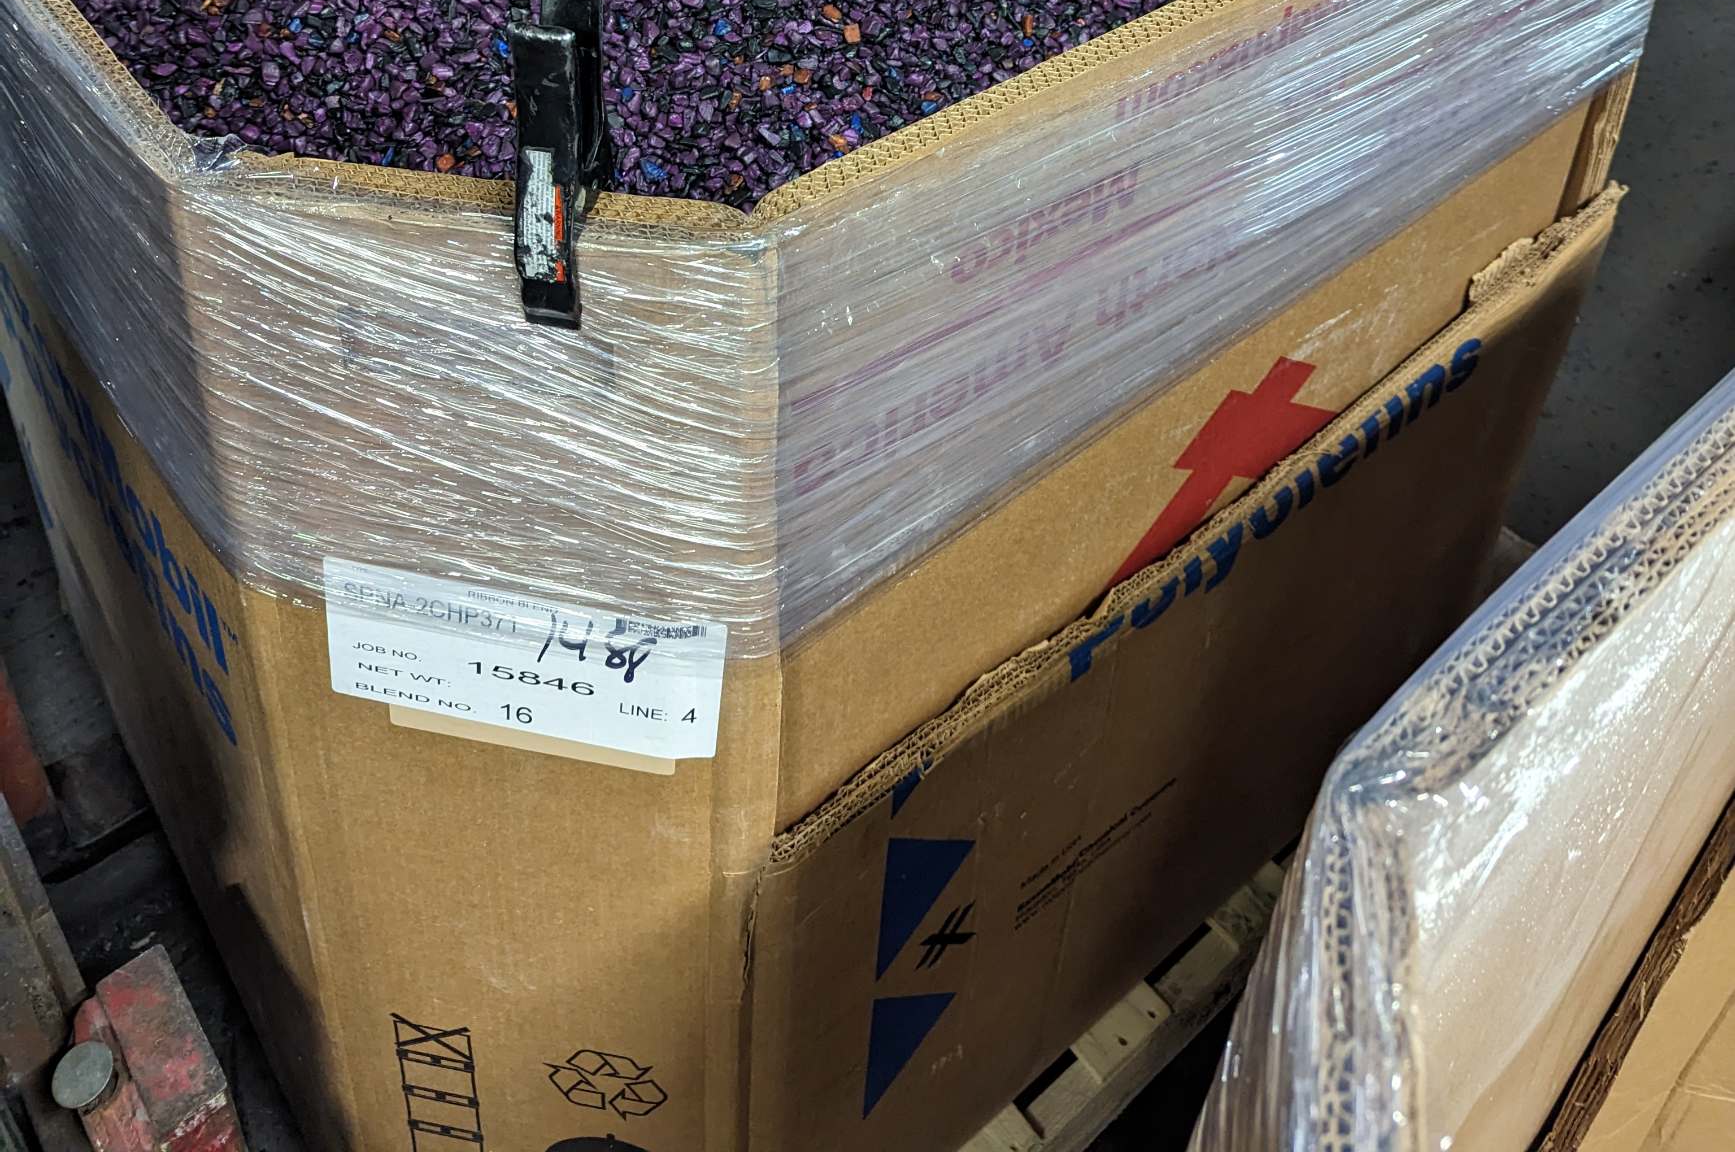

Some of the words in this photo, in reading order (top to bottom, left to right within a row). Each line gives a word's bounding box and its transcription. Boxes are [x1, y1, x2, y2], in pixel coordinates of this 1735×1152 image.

[352, 642, 386, 654] JOB
[468, 661, 595, 696] 15846
[358, 662, 403, 677] NET
[355, 682, 430, 703] BLEND
[500, 703, 533, 724] 16
[619, 702, 668, 722] LINE:
[681, 707, 698, 724] 4
